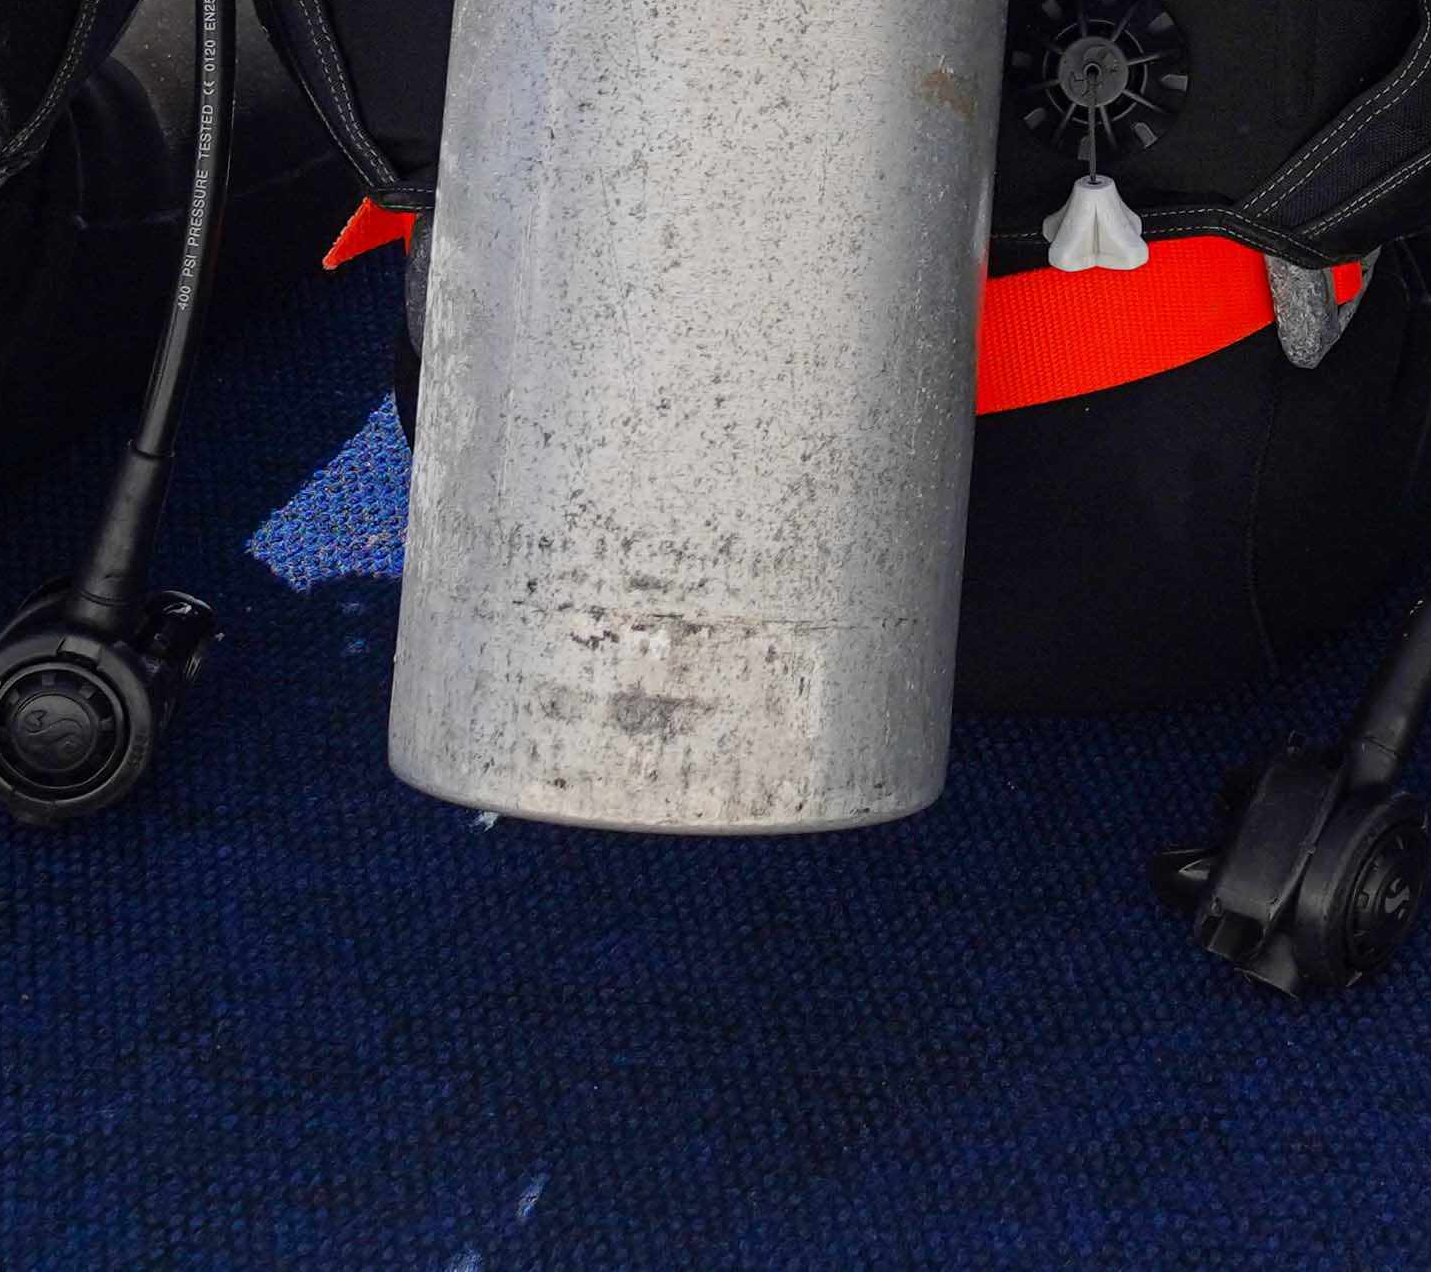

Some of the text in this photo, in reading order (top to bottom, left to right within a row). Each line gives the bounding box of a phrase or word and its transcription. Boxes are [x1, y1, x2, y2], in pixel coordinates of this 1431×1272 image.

[203, 39, 216, 72] 0120
[198, 103, 215, 159] TESTED
[188, 168, 209, 247] PRESSURE
[183, 252, 197, 279] PSI
[178, 284, 192, 311] 400
